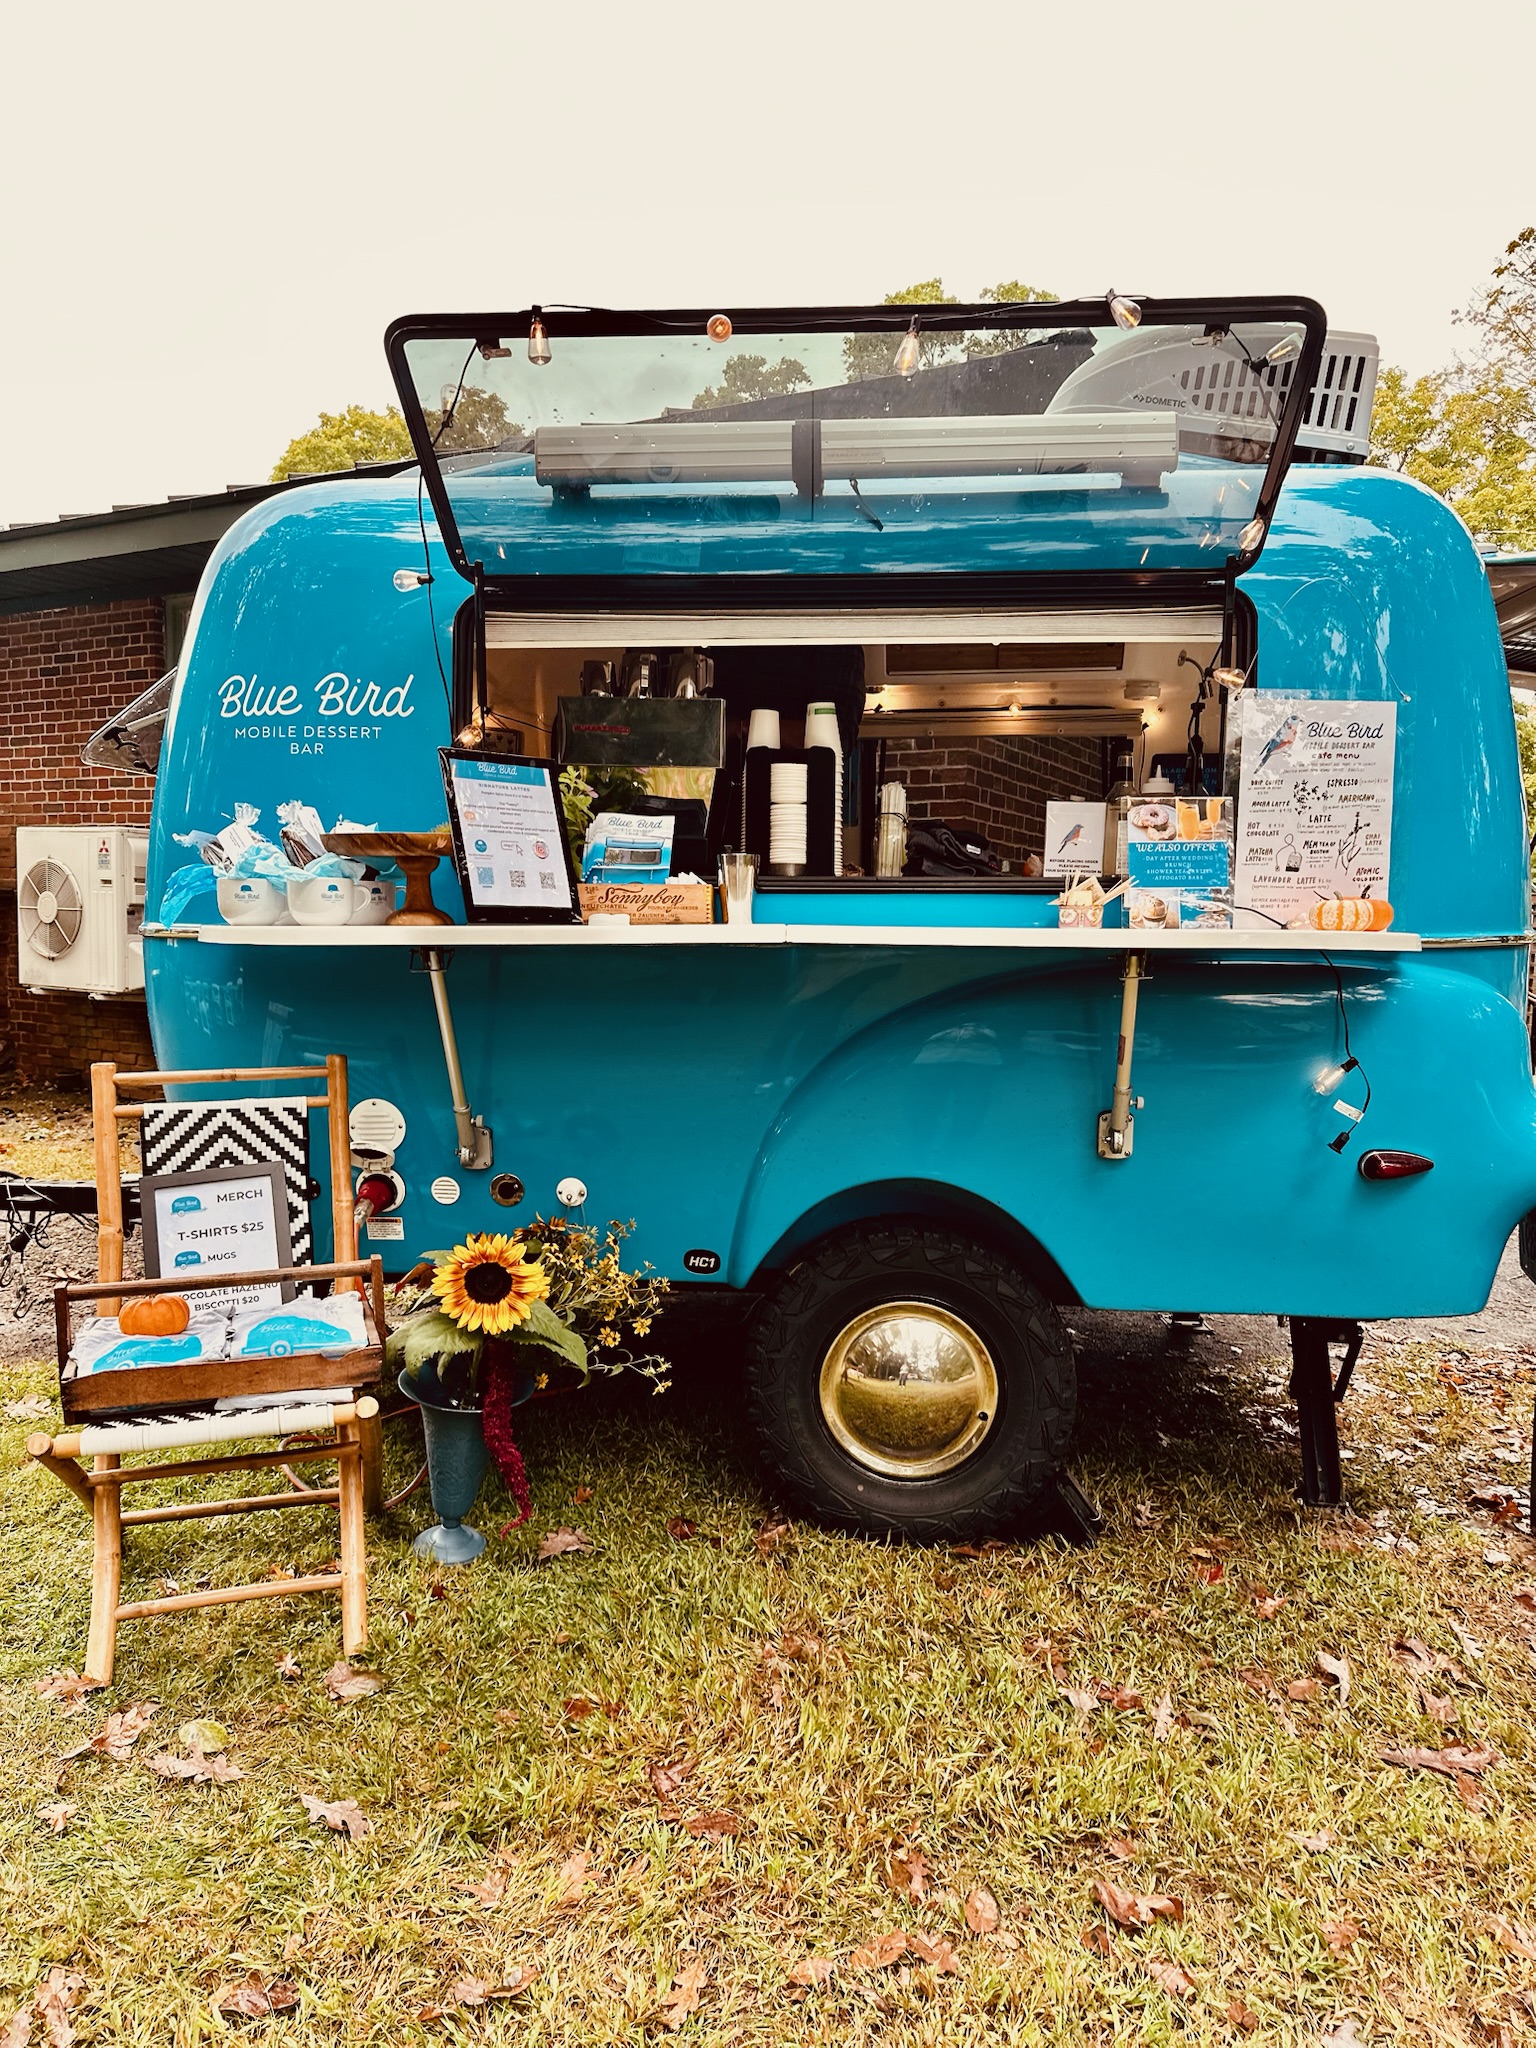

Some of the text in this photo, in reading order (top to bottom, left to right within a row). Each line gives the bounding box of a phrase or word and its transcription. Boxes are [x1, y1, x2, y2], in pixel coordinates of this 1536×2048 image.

[1145, 396, 1187, 408] DOMETIC
[218, 672, 415, 718] Blue Bird
[235, 725, 382, 739] MOBILE DESSERT
[1307, 721, 1384, 739] Blue Bird
[290, 742, 324, 755] BAR
[1331, 741, 1360, 750] DESSERT
[1362, 741, 1376, 750] BAR
[1312, 752, 1332, 760] cafe
[477, 762, 518, 776] Blue Bird
[1327, 778, 1359, 788] ESPRESSO
[1251, 800, 1270, 808] MOCHA
[1338, 794, 1375, 803] AMERICANO
[607, 816, 664, 829] Blue Bird
[1309, 814, 1332, 823] LATTE
[1247, 821, 1261, 830] HOT
[1136, 843, 1154, 852] WE
[1154, 843, 1181, 852] ALSO
[1303, 840, 1319, 849] MEM
[1248, 847, 1273, 856] MATCHA
[1356, 867, 1380, 876] ATOMIC
[1253, 875, 1292, 884] LAVENDER
[1297, 876, 1316, 885] LATTE
[598, 887, 685, 912] Sonnyboy
[217, 1189, 263, 1203] MERCH
[178, 1221, 265, 1241] T-SHIRTS $25
[207, 1251, 237, 1262] MUGS
[689, 1256, 715, 1268] HC1
[231, 1282, 279, 1295] HAZELNU
[242, 1295, 260, 1305] $20
[260, 1323, 338, 1337] Blue Bird
